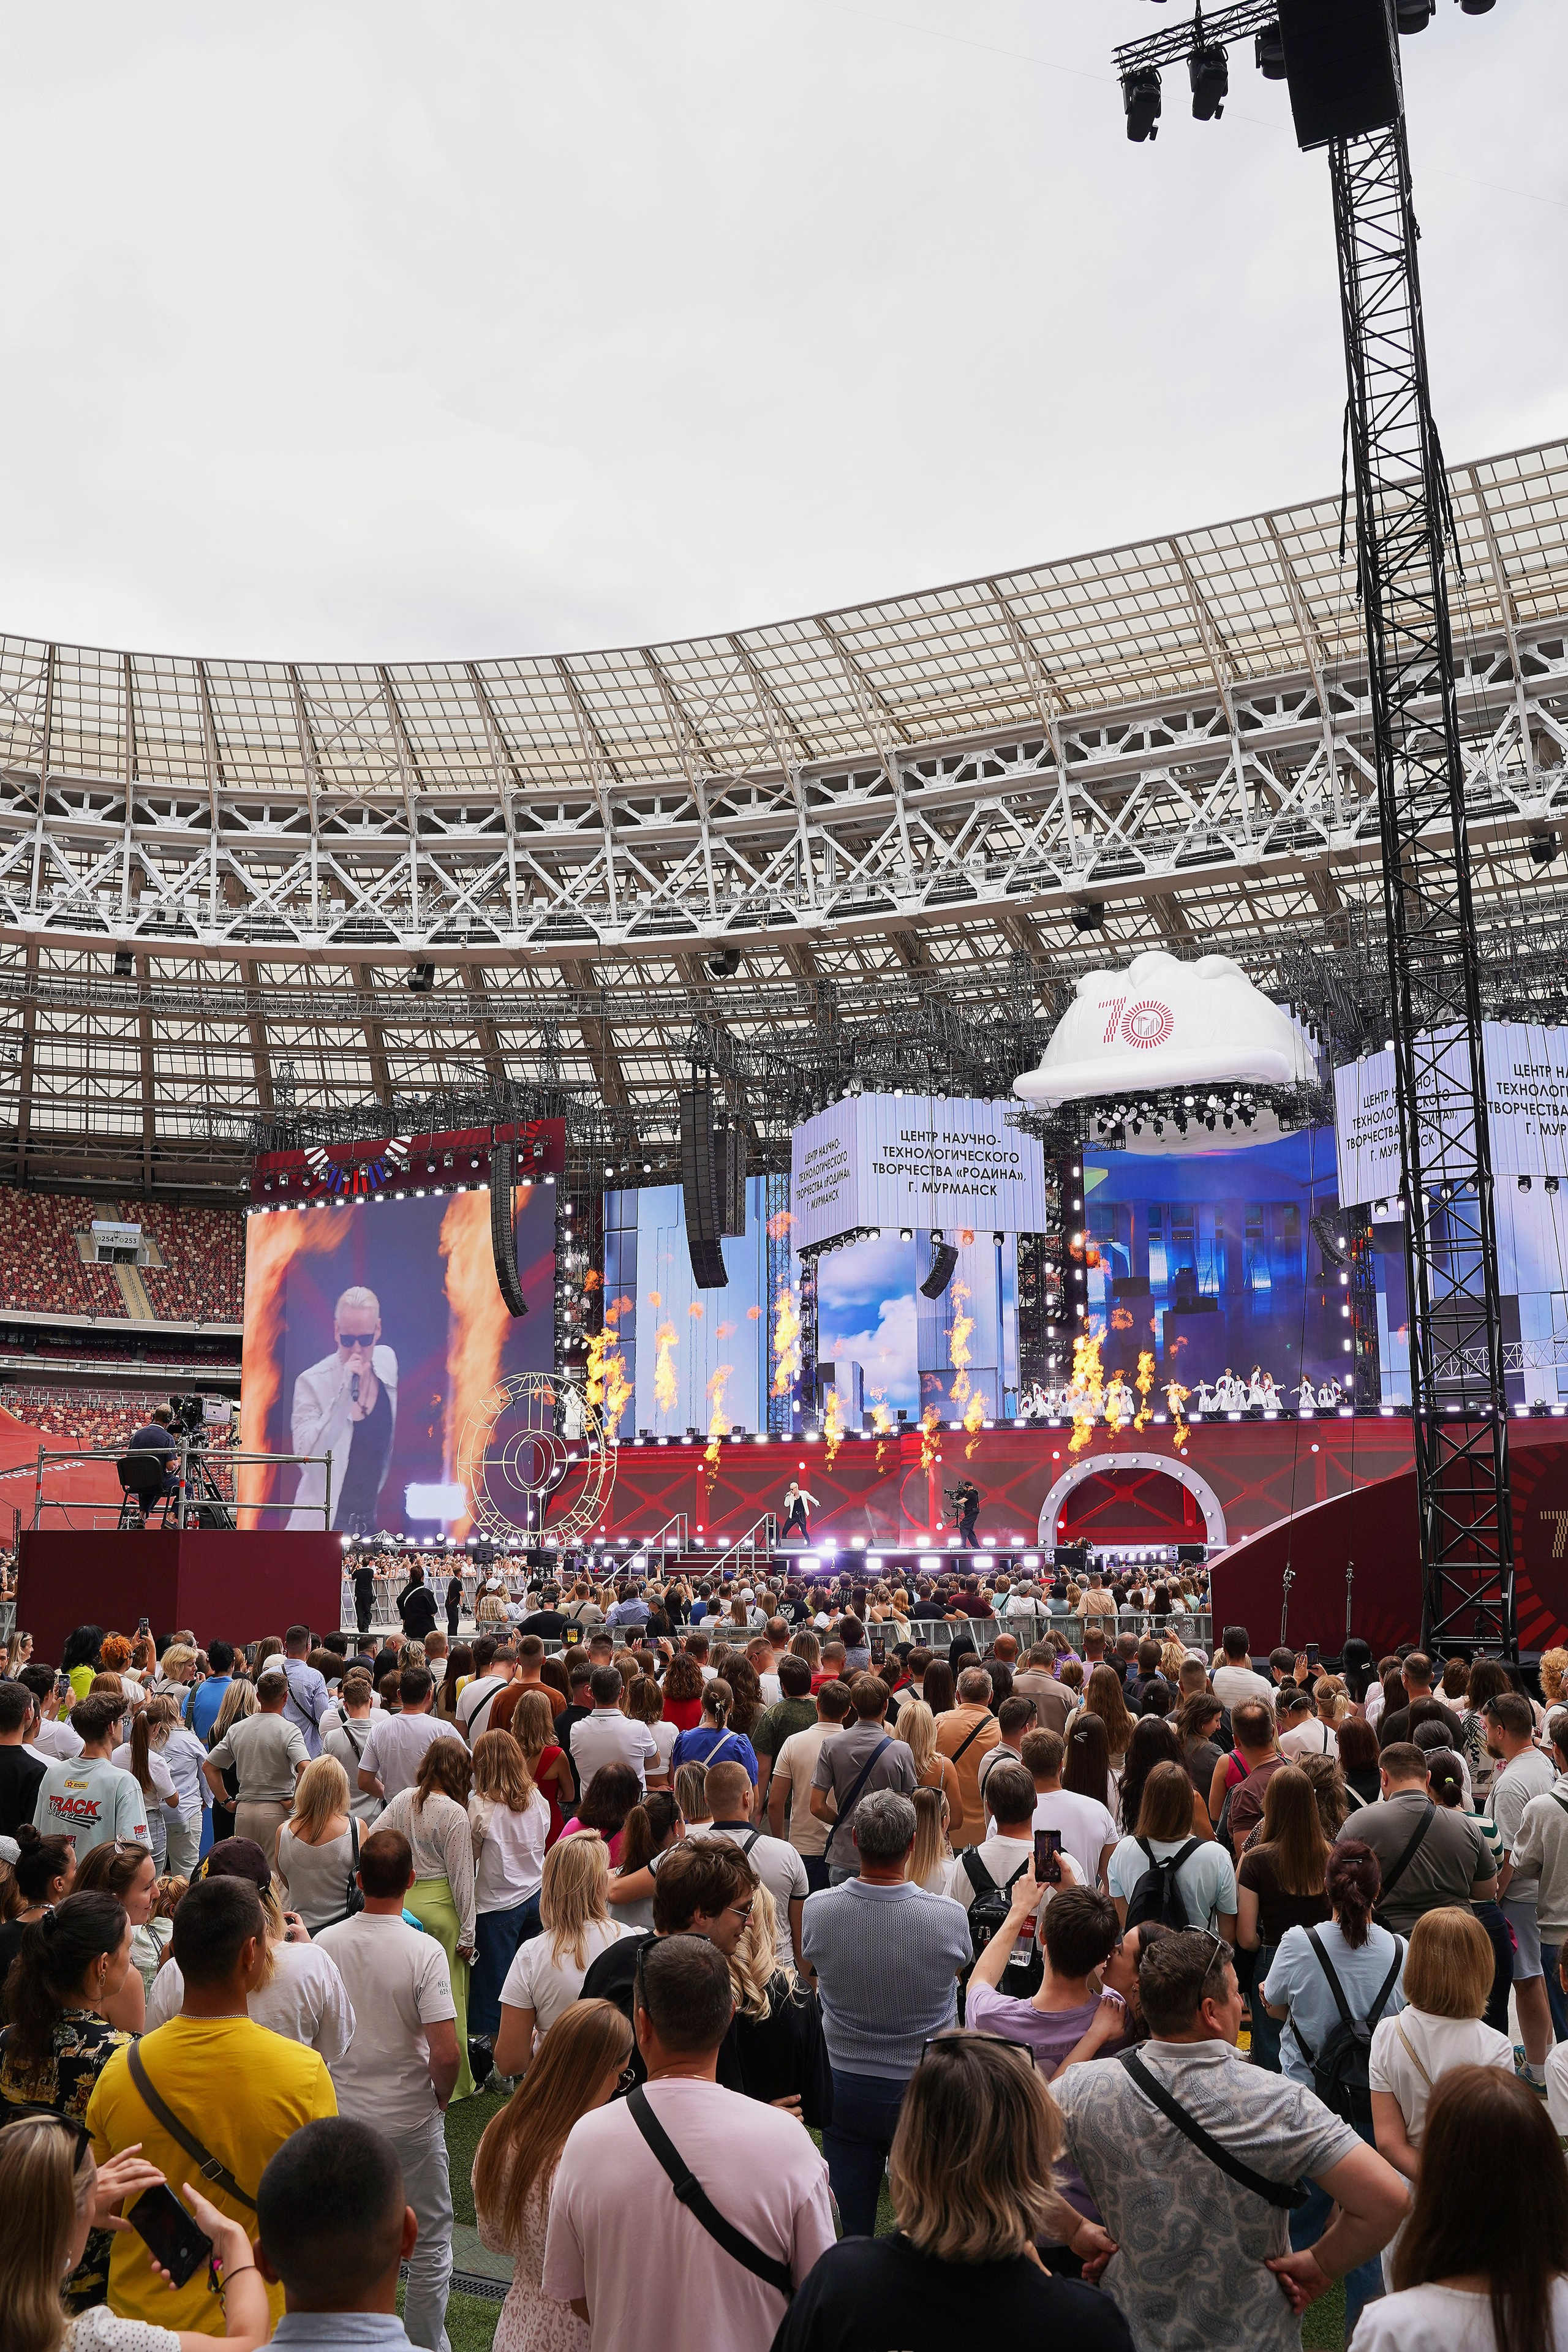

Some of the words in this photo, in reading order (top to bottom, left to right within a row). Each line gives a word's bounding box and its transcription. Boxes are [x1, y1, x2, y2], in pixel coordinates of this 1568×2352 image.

[1513, 1064, 1551, 1078] ЦЕНТР
[1556, 1066, 1568, 1078] Н
[1363, 1088, 1389, 1108] ЦЕНТР
[1392, 1075, 1434, 1099] ННО-
[1496, 1082, 1568, 1097] ТЕХНОЛОГ
[1352, 1088, 1450, 1130] ТЕХНОЛОГСКОГО
[901, 1129, 938, 1143] ЦЕНТР
[943, 1132, 1001, 1145] НАУЧНО-
[1347, 1123, 1400, 1151] ТВОРЧЕСТВА
[1526, 1122, 1536, 1135] Г.
[804, 1149, 818, 1165] ЦЕНТР
[819, 1138, 841, 1158] НАУЧНО-
[883, 1146, 1019, 1164] ТЕХНОЛОГИЧЕСКОГО
[1370, 1150, 1378, 1162] Г.
[1379, 1132, 1435, 1159] МУРСК
[799, 1150, 848, 1184] ТЕХНОЛОГИЧЕСКОГО
[872, 1163, 952, 1177] ТВОРЧЕСТВА
[956, 1167, 1027, 1182] «РОДИНА»,
[796, 1179, 823, 1201] ТВОРЧЕСТВА
[908, 1182, 918, 1193] Г.
[922, 1182, 997, 1196] МУРМАНСК
[807, 1201, 810, 1212] Г.
[811, 1188, 839, 1210] МУРМАНСК
[50, 1795, 103, 1816] TRACK
